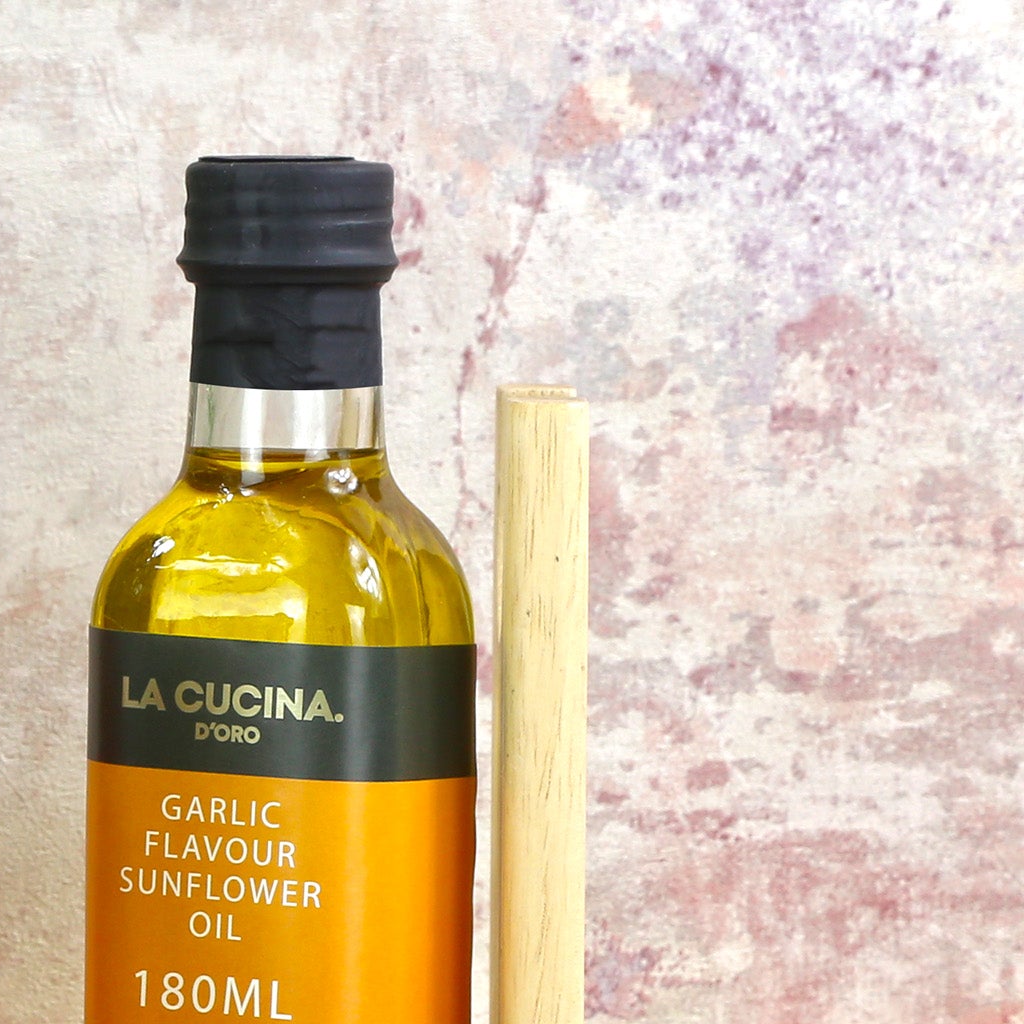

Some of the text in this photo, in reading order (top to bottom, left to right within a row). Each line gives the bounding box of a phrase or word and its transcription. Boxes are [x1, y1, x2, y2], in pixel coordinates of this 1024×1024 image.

[122, 675, 344, 723] LA CUCINA.
[161, 794, 281, 828] GARLIC
[145, 830, 296, 867] FLAVOUR
[120, 866, 321, 908] SUNFLOWER
[189, 911, 242, 941] OIL
[134, 969, 293, 1021] 180ML
